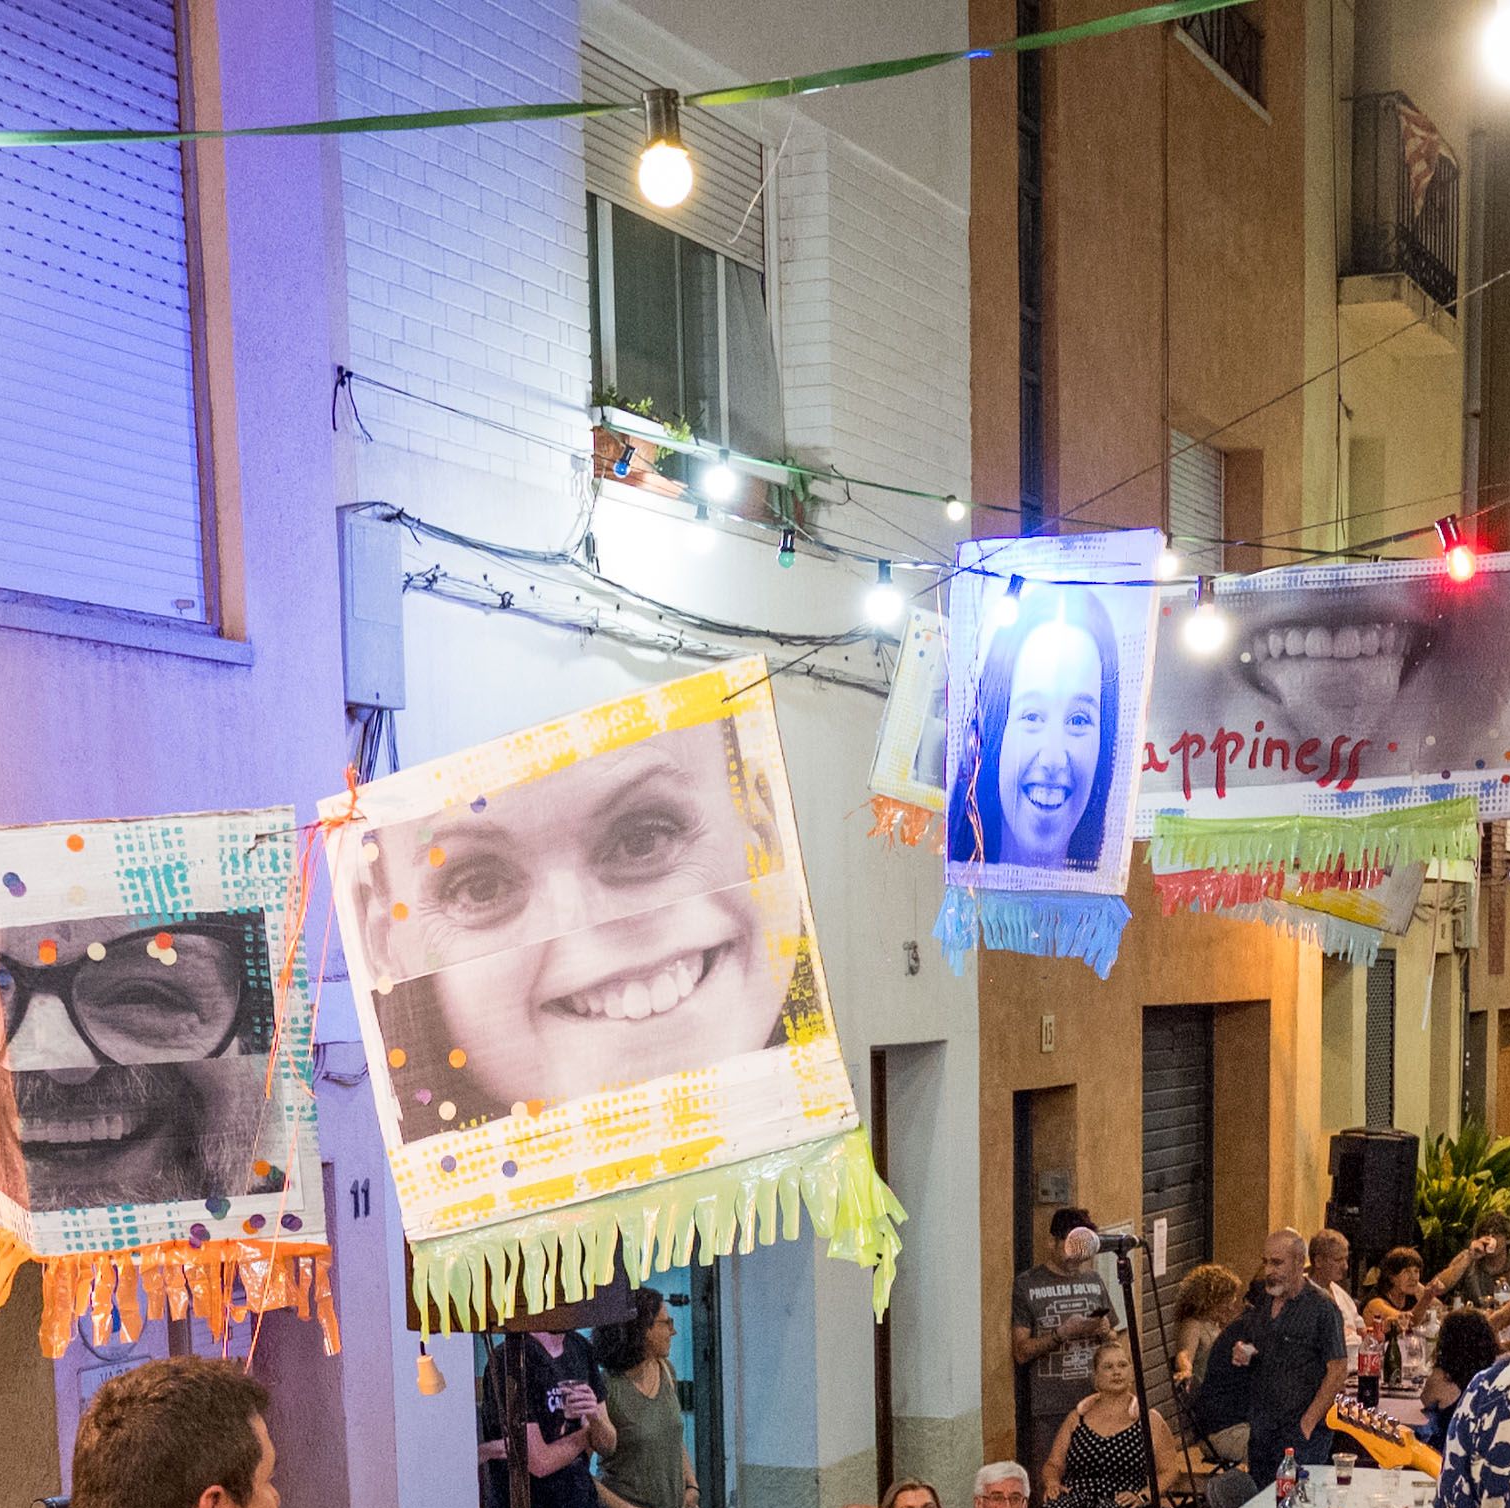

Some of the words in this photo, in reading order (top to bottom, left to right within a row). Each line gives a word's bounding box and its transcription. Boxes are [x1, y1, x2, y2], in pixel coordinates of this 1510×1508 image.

[1141, 720, 1373, 802] appiness
[1044, 1022, 1053, 1046] 15
[349, 1177, 371, 1220] 11
[1029, 1284, 1071, 1300] PROBLEM
